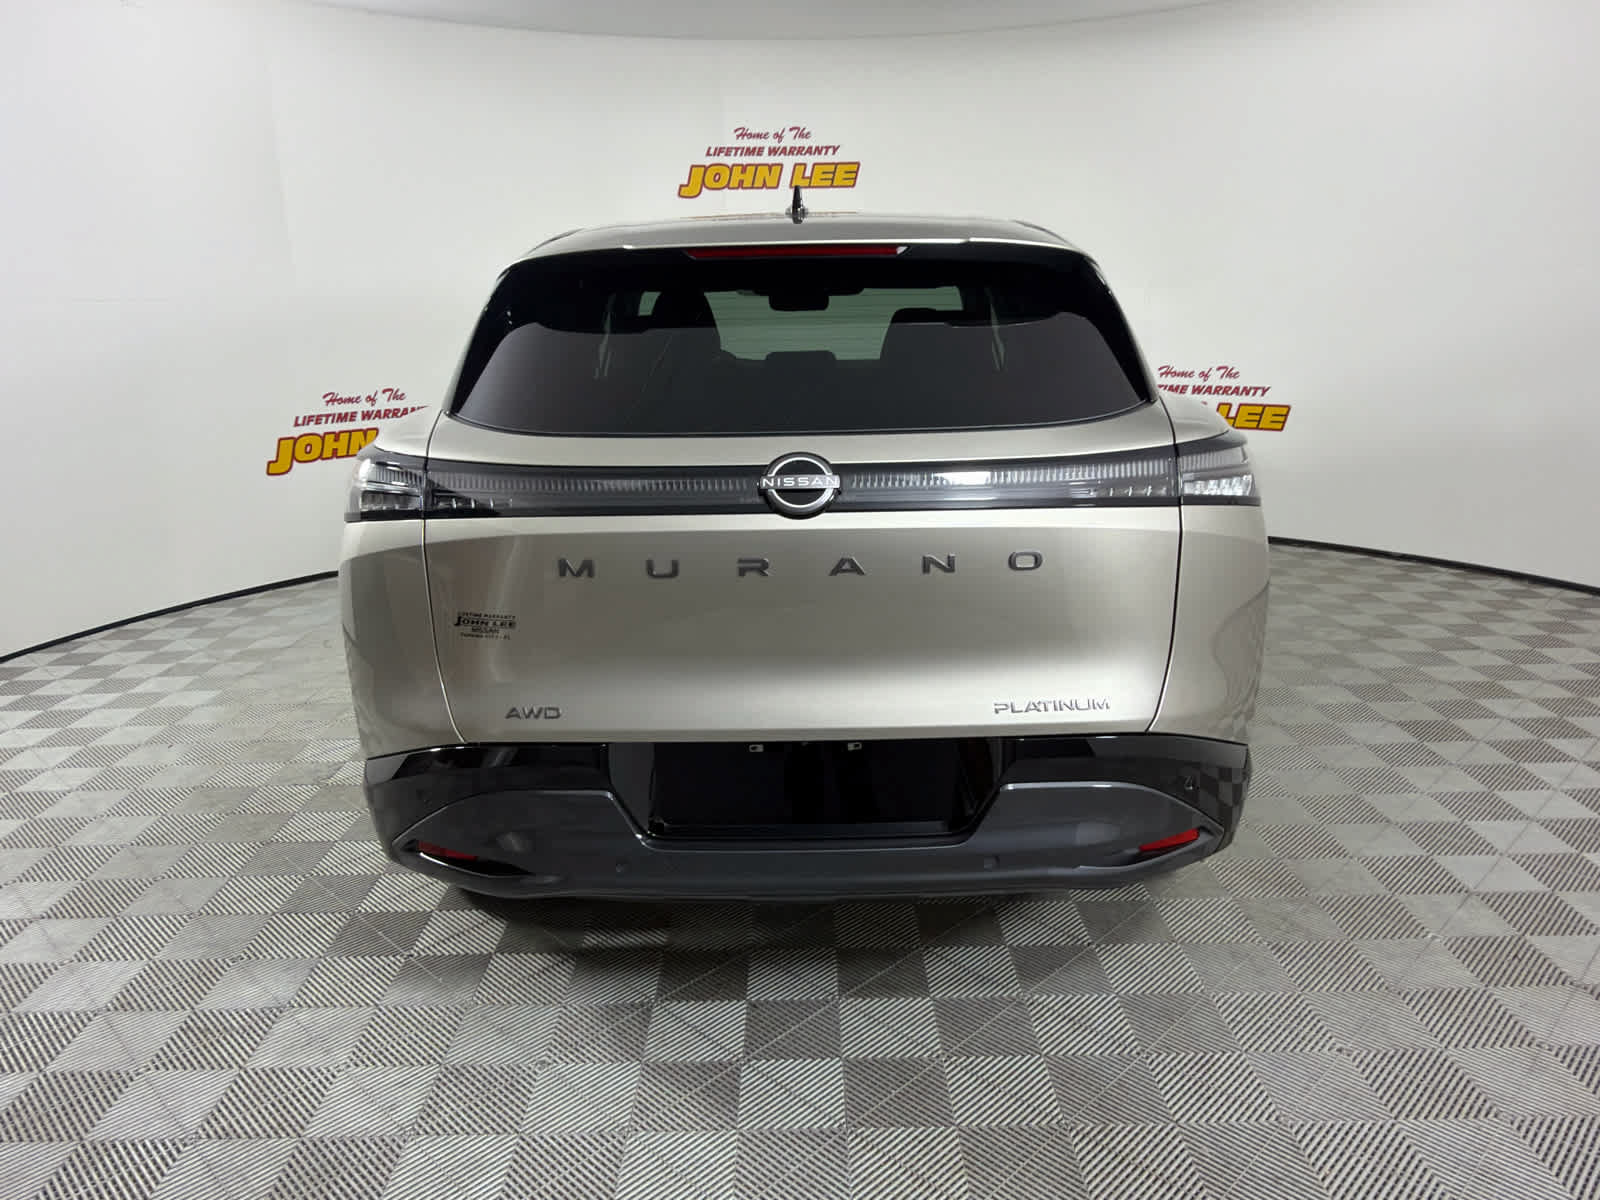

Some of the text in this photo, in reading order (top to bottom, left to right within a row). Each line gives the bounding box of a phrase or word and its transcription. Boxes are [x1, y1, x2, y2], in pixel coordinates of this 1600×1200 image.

[733, 126, 812, 144] Home of The
[705, 145, 840, 157] LIFETIME WARRANTY
[678, 162, 860, 198] JOHN LEE
[1157, 365, 1240, 382] Home of The
[322, 388, 407, 407] Home of The
[1191, 385, 1271, 397] WARRANTY
[293, 411, 358, 427] LIFETIME
[1216, 402, 1292, 432] LEE
[266, 427, 379, 476] JOHN
[762, 476, 839, 488] NISSAN
[557, 551, 1044, 579] MURANO
[453, 615, 490, 628] JOHN
[505, 707, 562, 720] AWD
[993, 698, 1111, 715] PLATINUM
